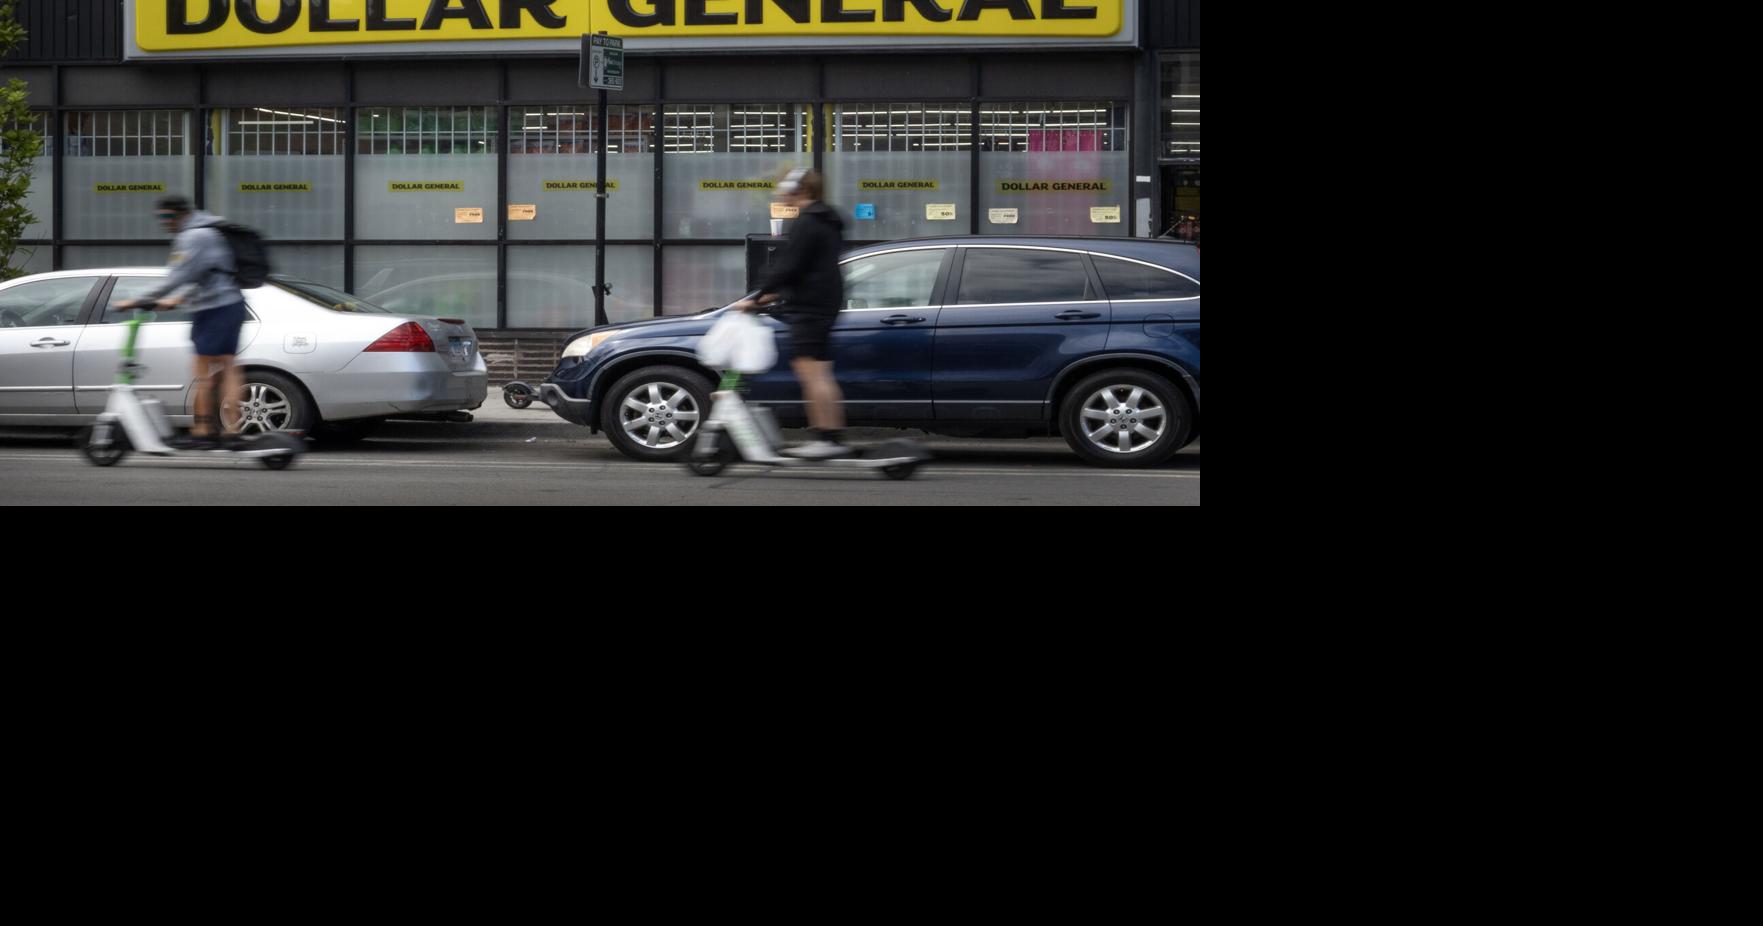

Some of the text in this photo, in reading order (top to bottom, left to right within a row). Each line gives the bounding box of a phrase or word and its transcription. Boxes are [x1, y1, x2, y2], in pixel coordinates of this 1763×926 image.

[273, 183, 308, 191] GENERAL
[1001, 182, 1107, 191] DOLLAR GENERAL
